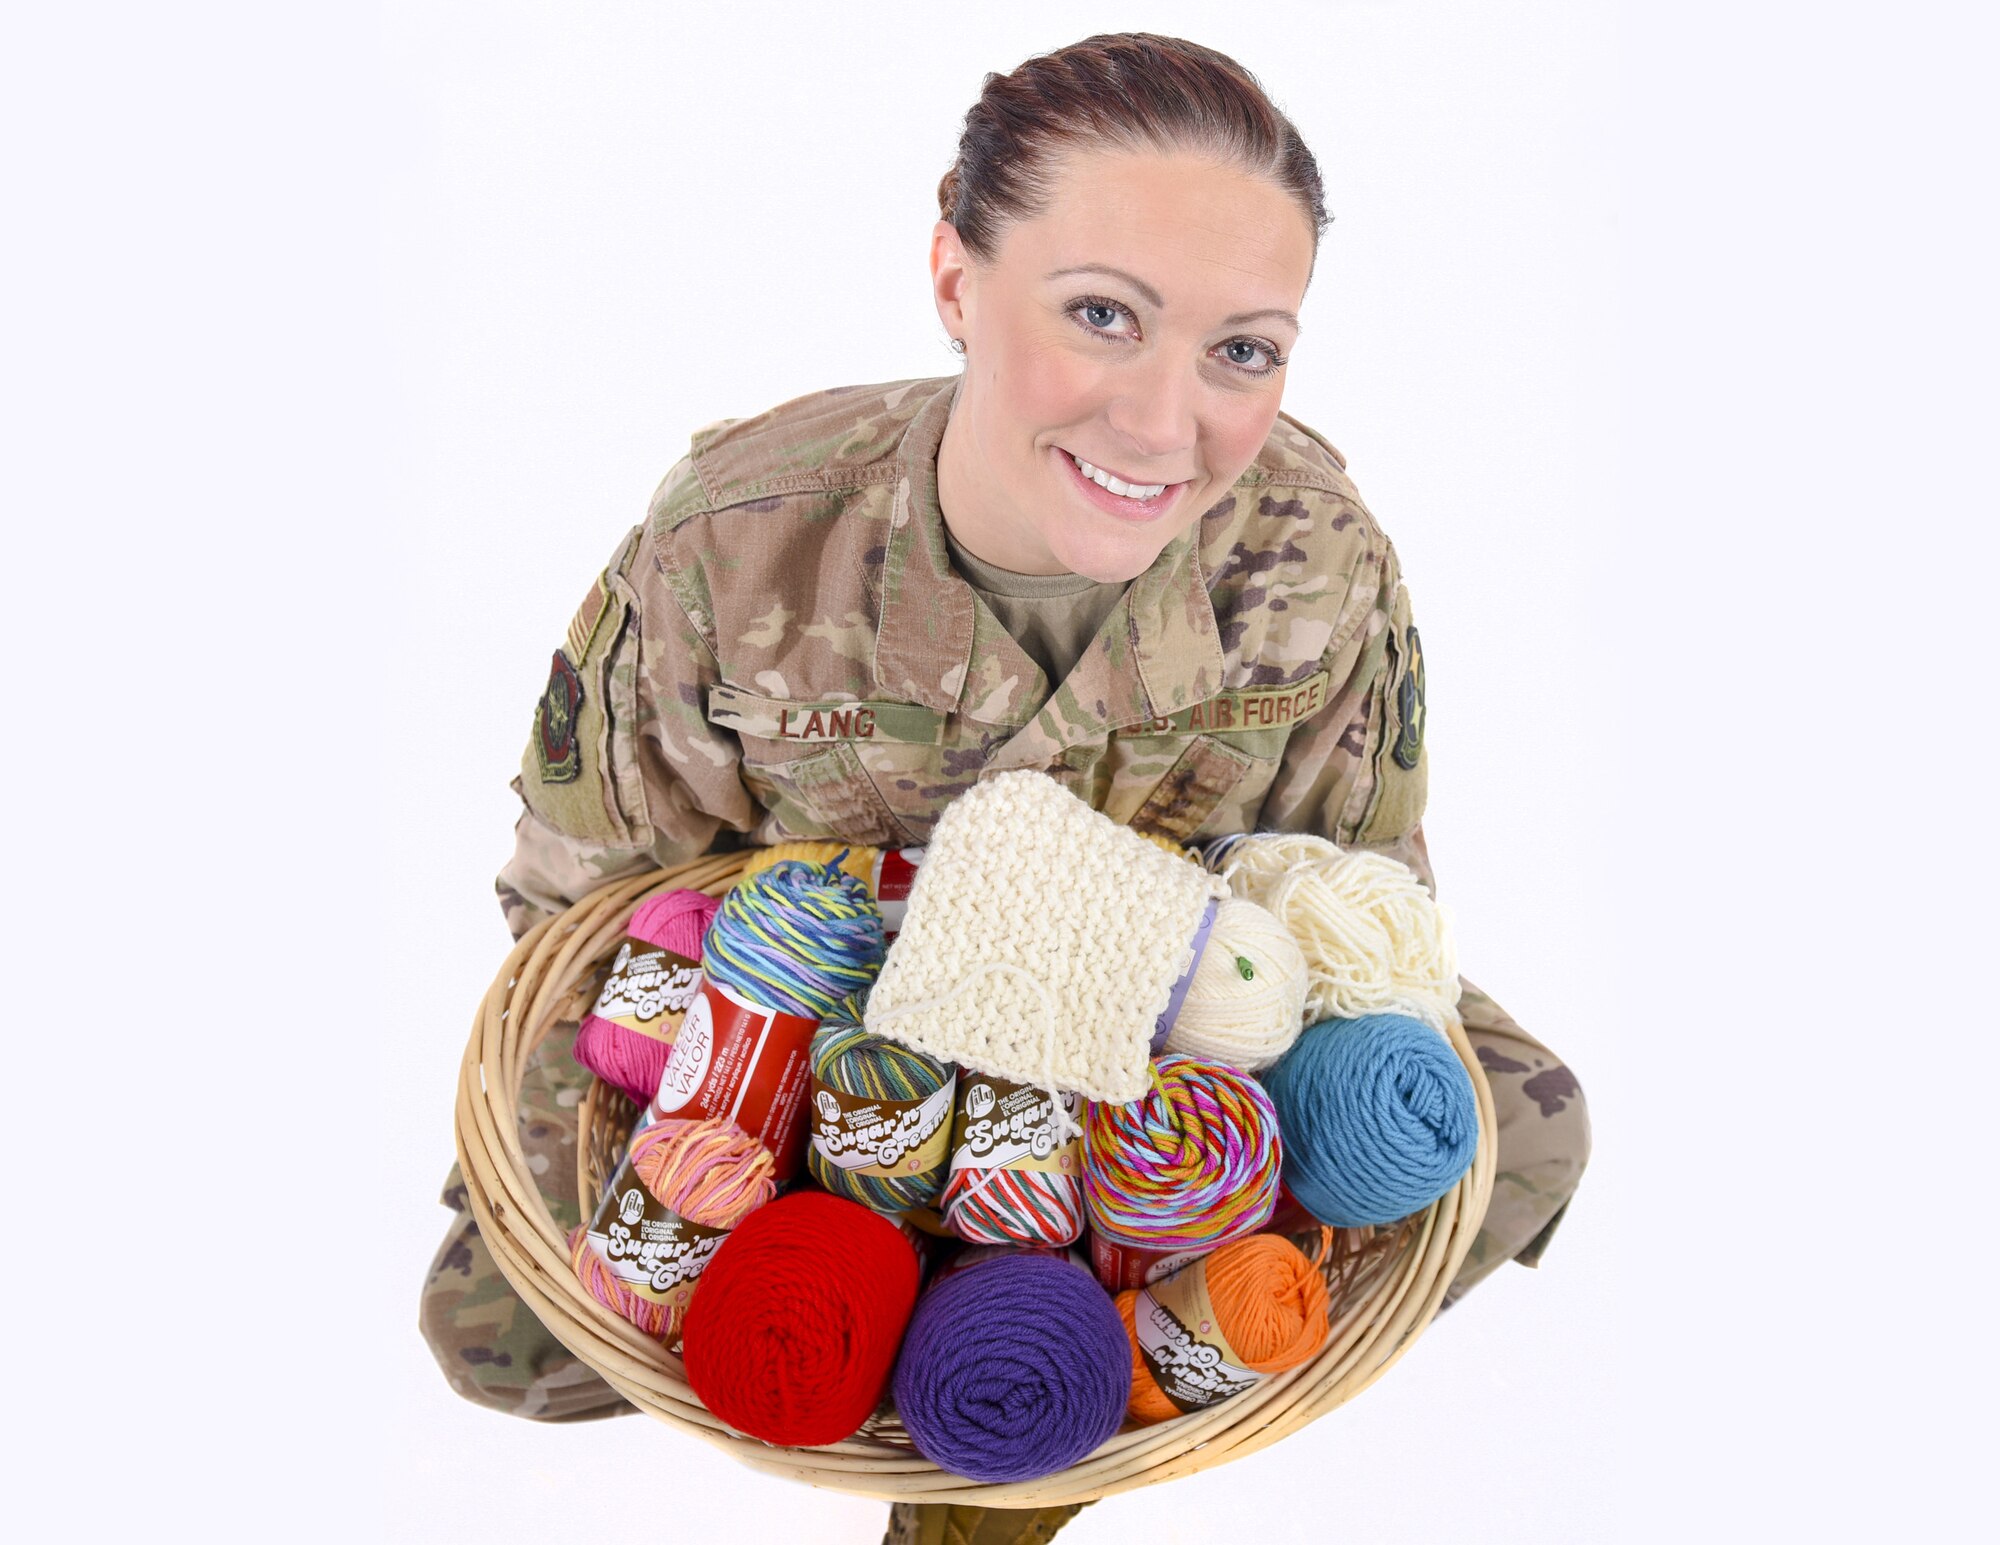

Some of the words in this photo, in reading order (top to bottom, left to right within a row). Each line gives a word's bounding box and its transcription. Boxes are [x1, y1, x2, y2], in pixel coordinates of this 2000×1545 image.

[1189, 698, 1236, 731] AIR
[1243, 683, 1320, 726] FORCE
[779, 708, 876, 739] LANG
[666, 1014, 700, 1087] VALEUR
[677, 1031, 710, 1095] VALOR
[700, 1093, 711, 1109] 244
[707, 1078, 718, 1094] yds
[714, 1056, 725, 1073] 223
[721, 1047, 729, 1057] m
[852, 1103, 882, 1117] ORIGINAL
[855, 1115, 884, 1128] ORIGINAL
[1003, 1109, 1011, 1118] EL
[1011, 1095, 1041, 1113] ORIGINAL
[866, 1100, 950, 1167] Cream
[641, 1232, 647, 1240] EL
[648, 1233, 679, 1241] ORIGINAL
[651, 1220, 684, 1229] ORIGINAL
[646, 1258, 705, 1292] Cre
[1150, 1307, 1220, 1378] Cream
[1175, 1378, 1204, 1395] ORIGINAL
